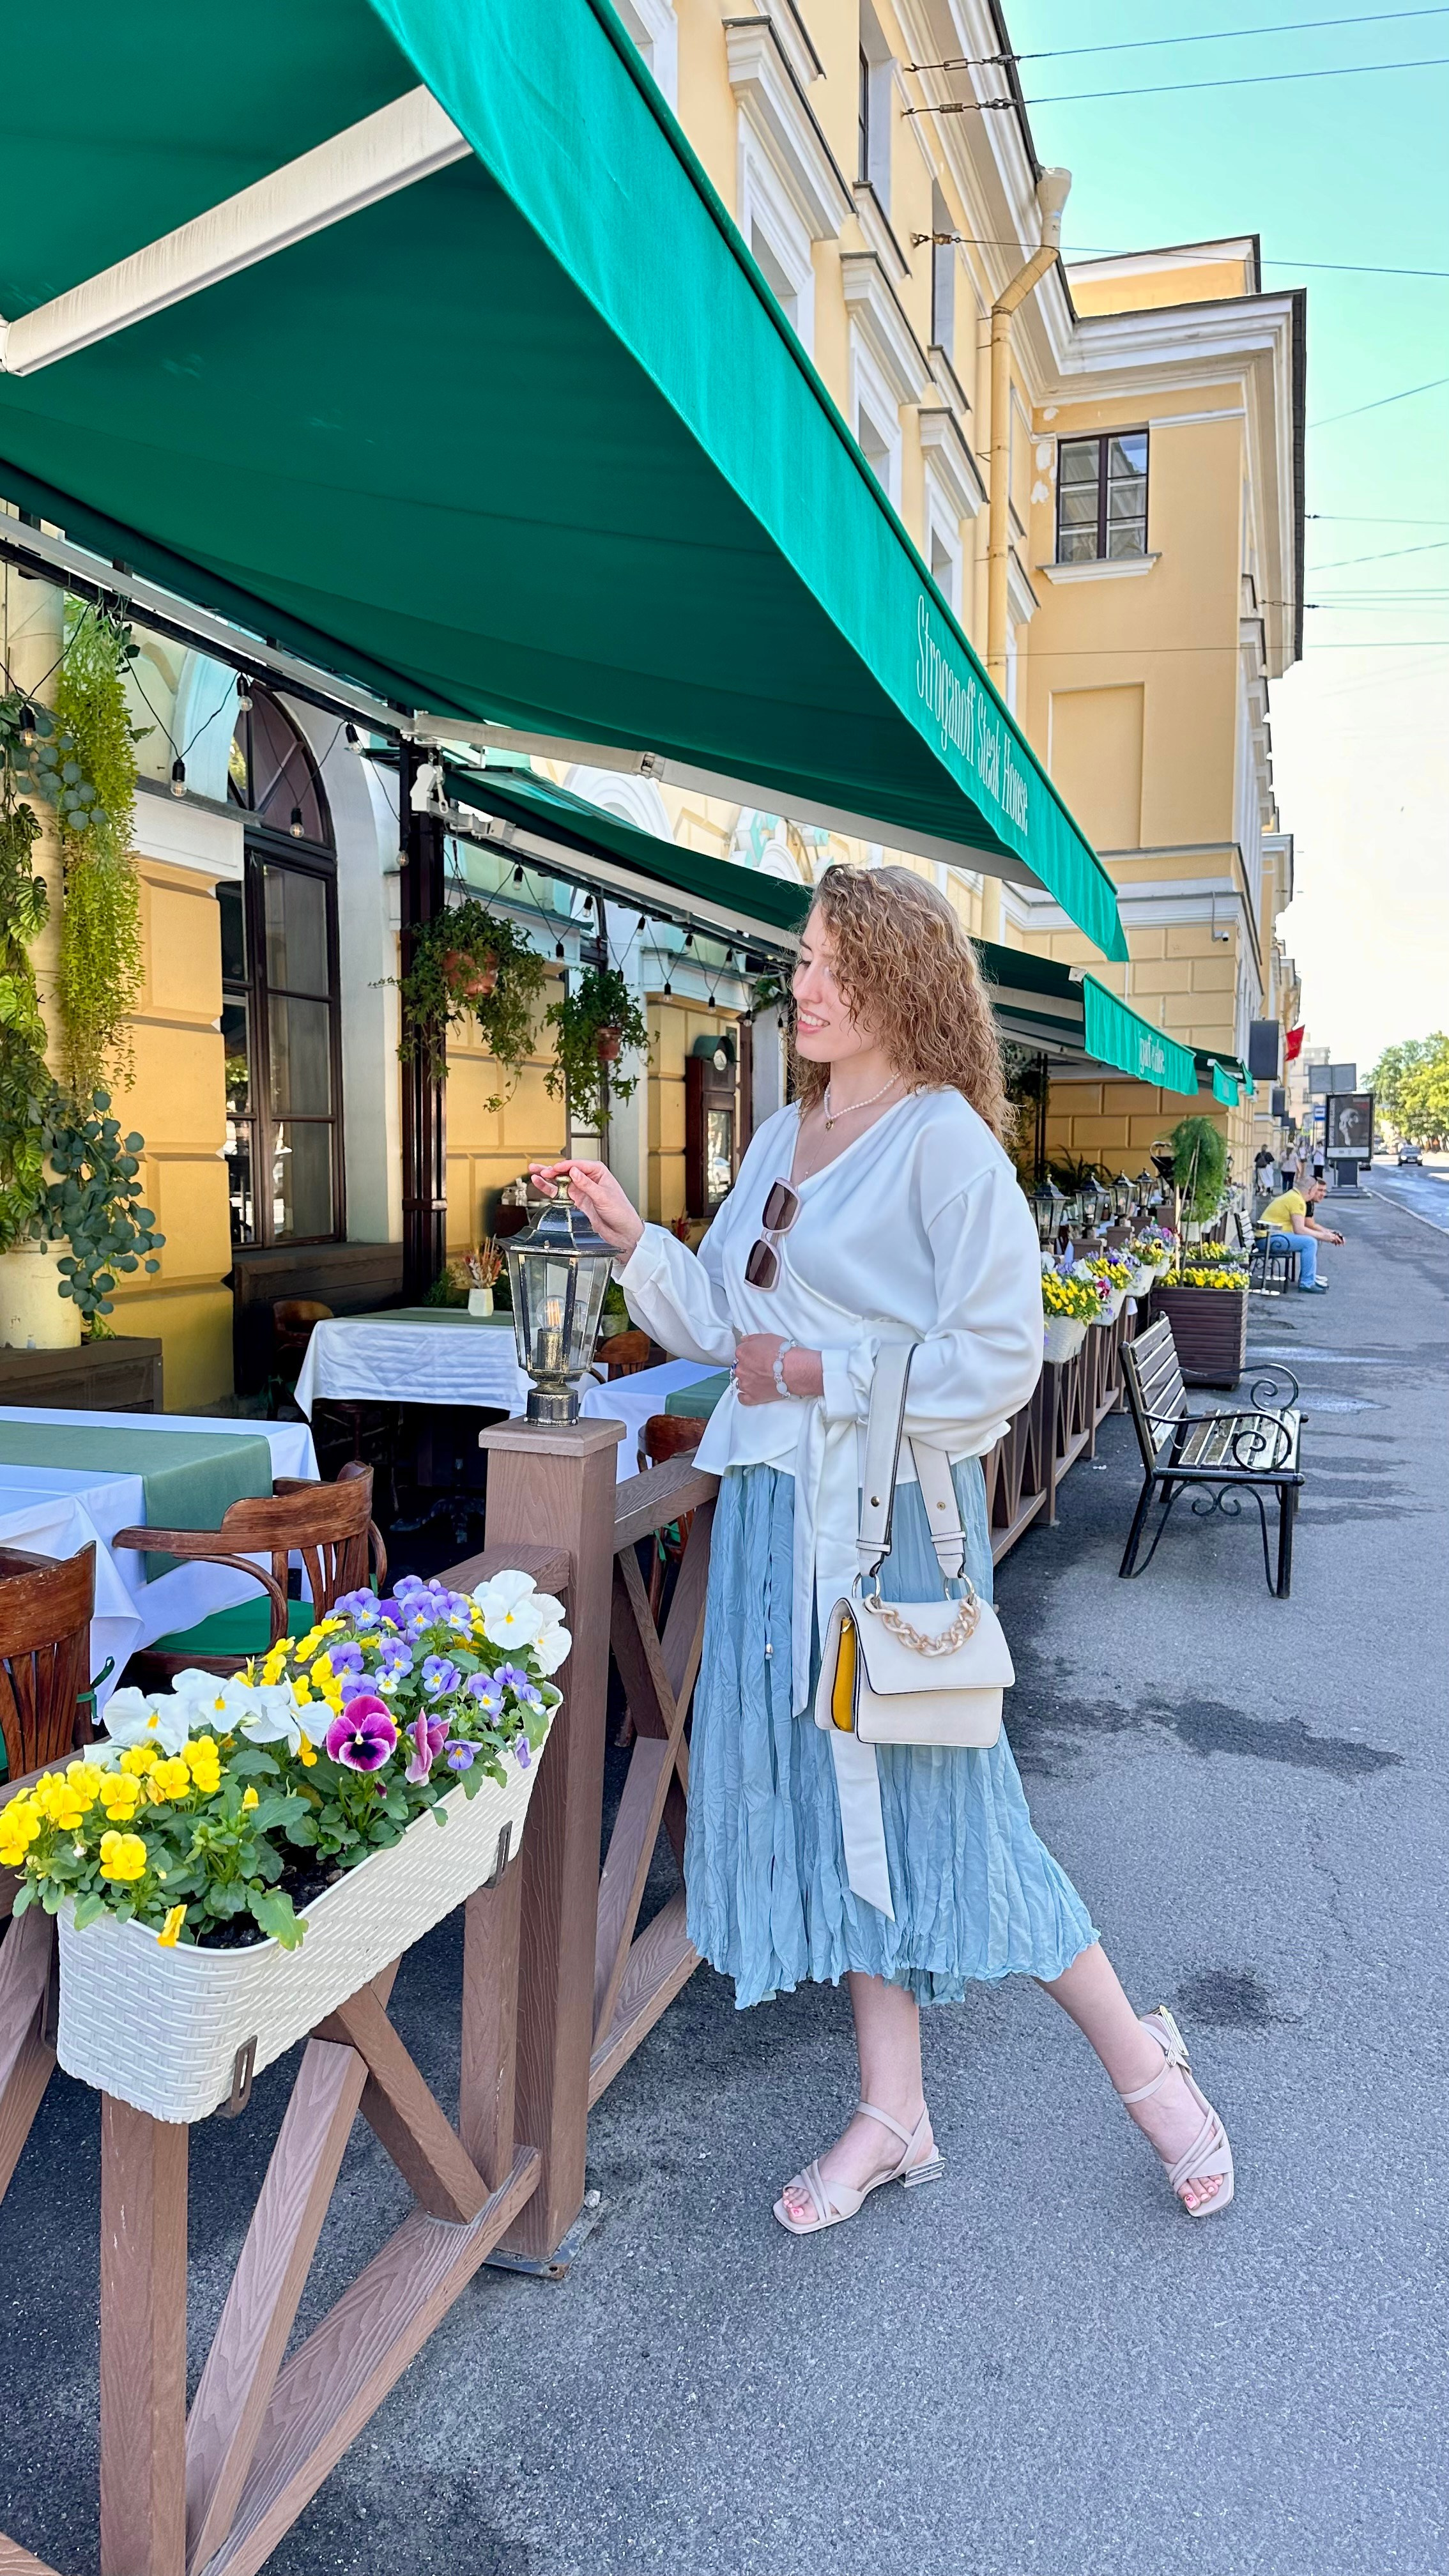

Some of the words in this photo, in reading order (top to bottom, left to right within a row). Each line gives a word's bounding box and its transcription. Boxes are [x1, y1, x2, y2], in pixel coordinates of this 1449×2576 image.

[916, 594, 976, 766] Stroganoff
[977, 692, 1001, 803] Steak
[1001, 733, 1028, 836] House
